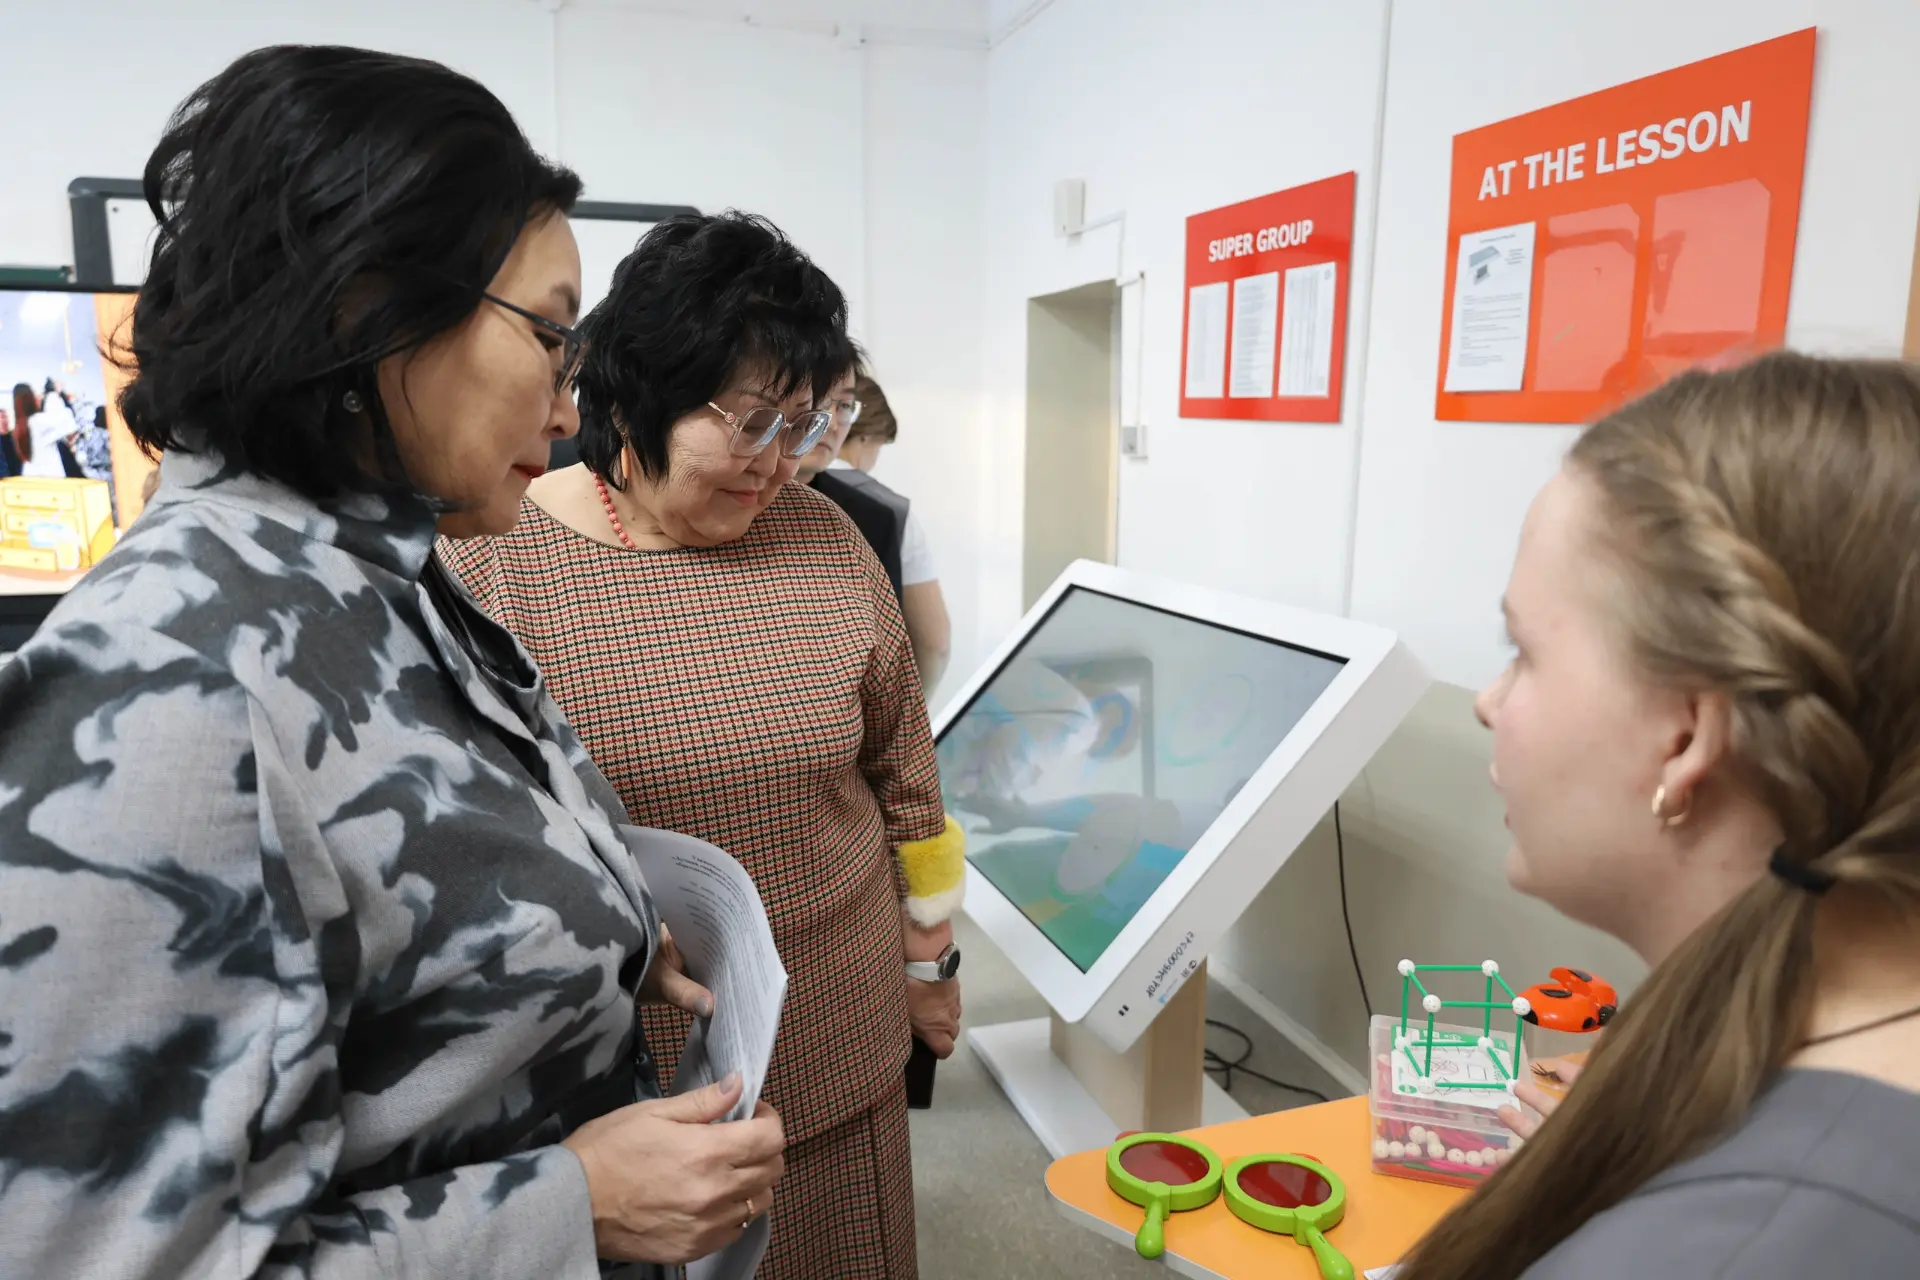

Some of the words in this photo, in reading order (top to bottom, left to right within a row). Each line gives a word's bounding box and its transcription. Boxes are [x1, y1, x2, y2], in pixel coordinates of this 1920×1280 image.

[1477, 160, 1517, 201] AT
[1523, 142, 1586, 190] THE
[1595, 100, 1752, 175] LESSON
[1208, 231, 1254, 262] SUPER
[1256, 219, 1314, 253] GROUP
